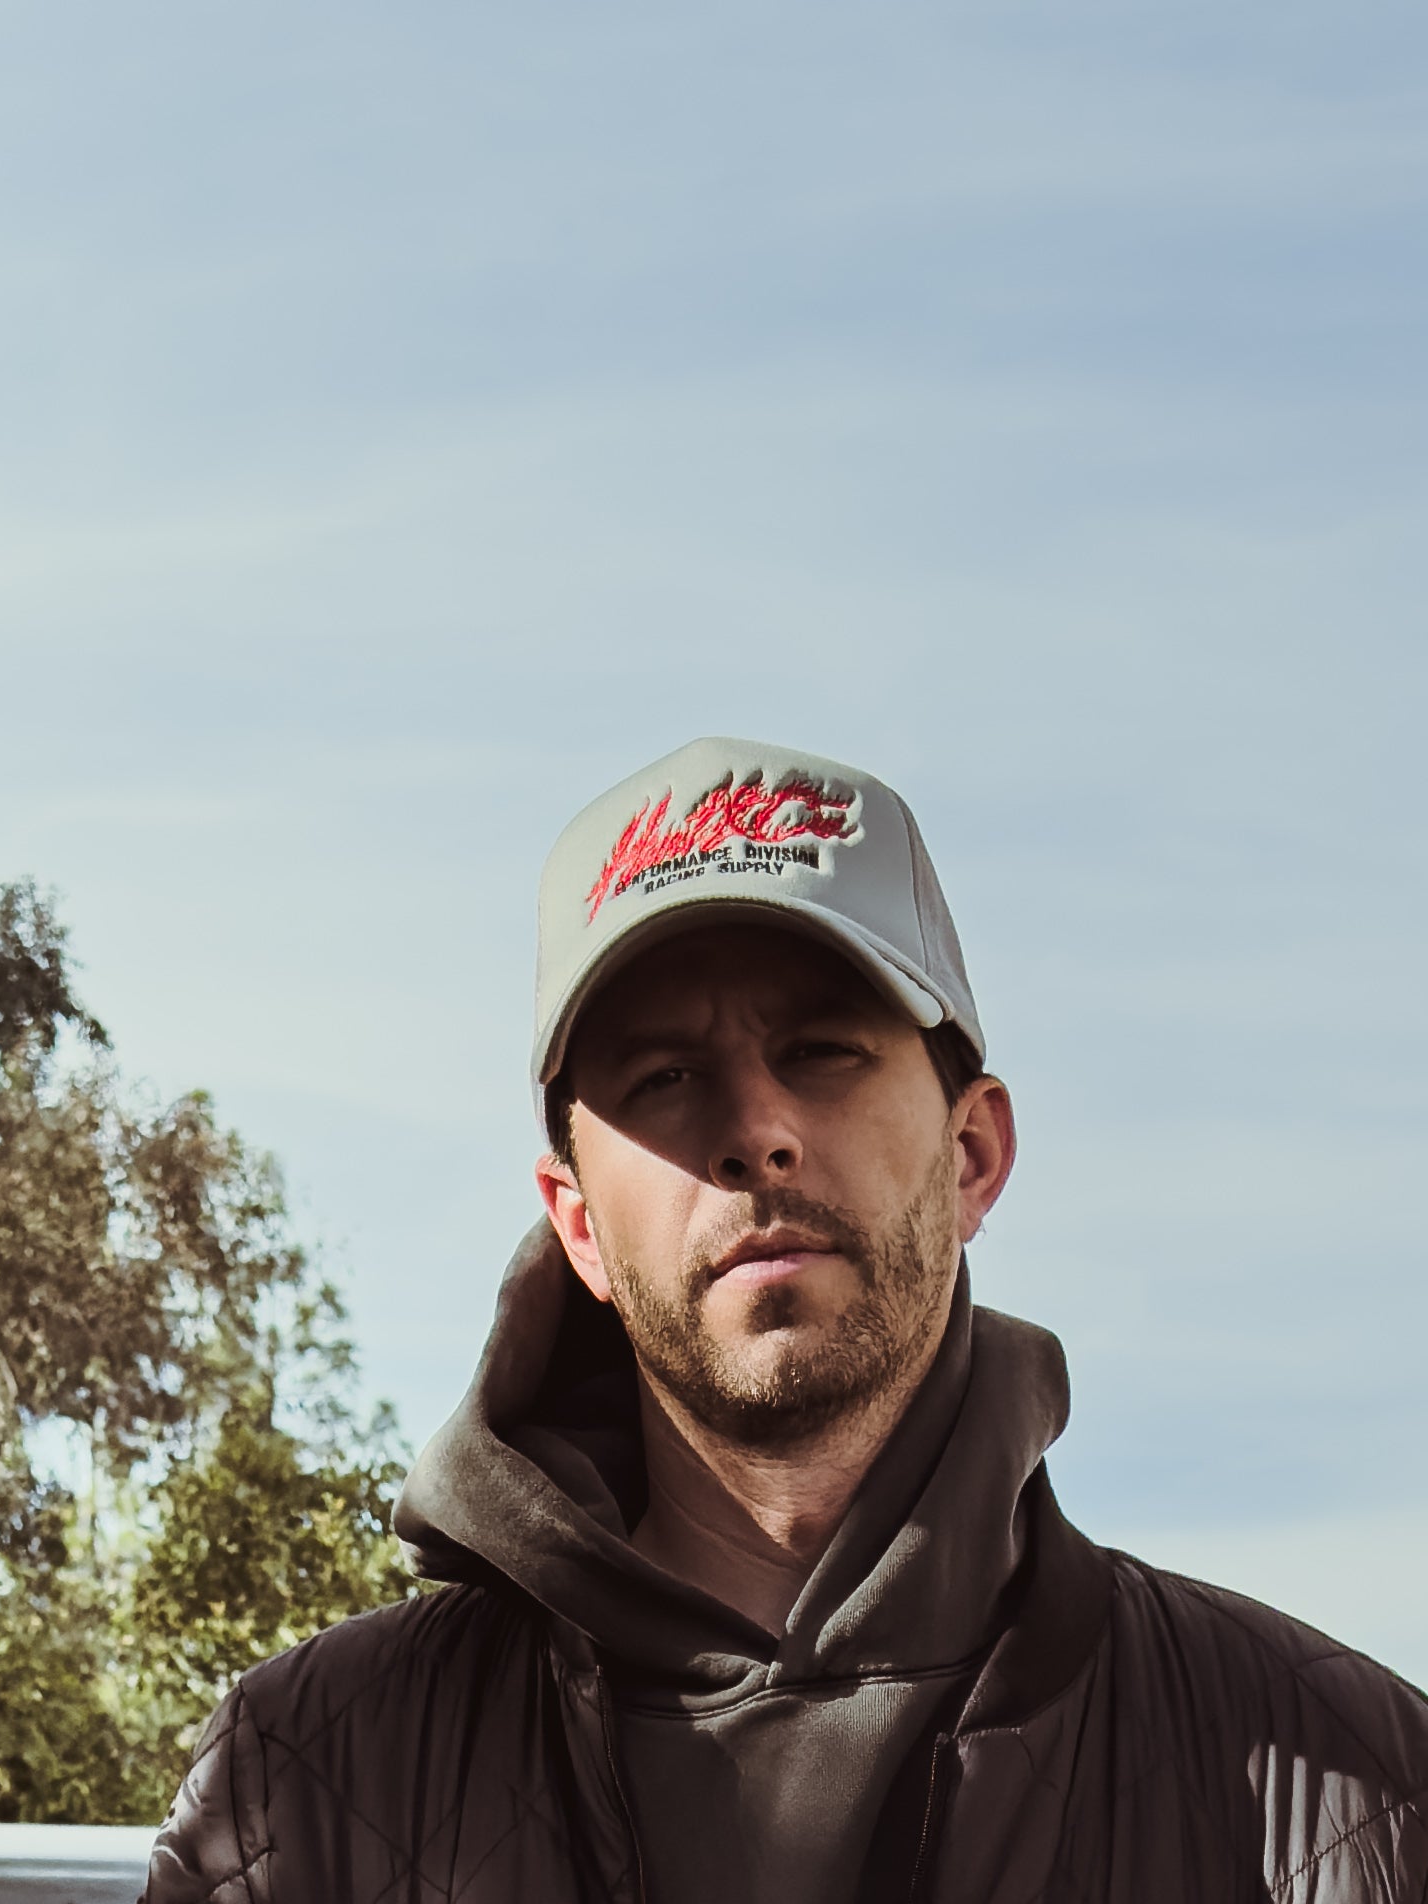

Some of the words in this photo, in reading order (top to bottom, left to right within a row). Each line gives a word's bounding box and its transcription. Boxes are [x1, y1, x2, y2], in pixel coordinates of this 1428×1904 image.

[746, 843, 821, 869] DIVISION
[645, 865, 705, 894] RACING
[718, 860, 784, 877] SUPPLY
